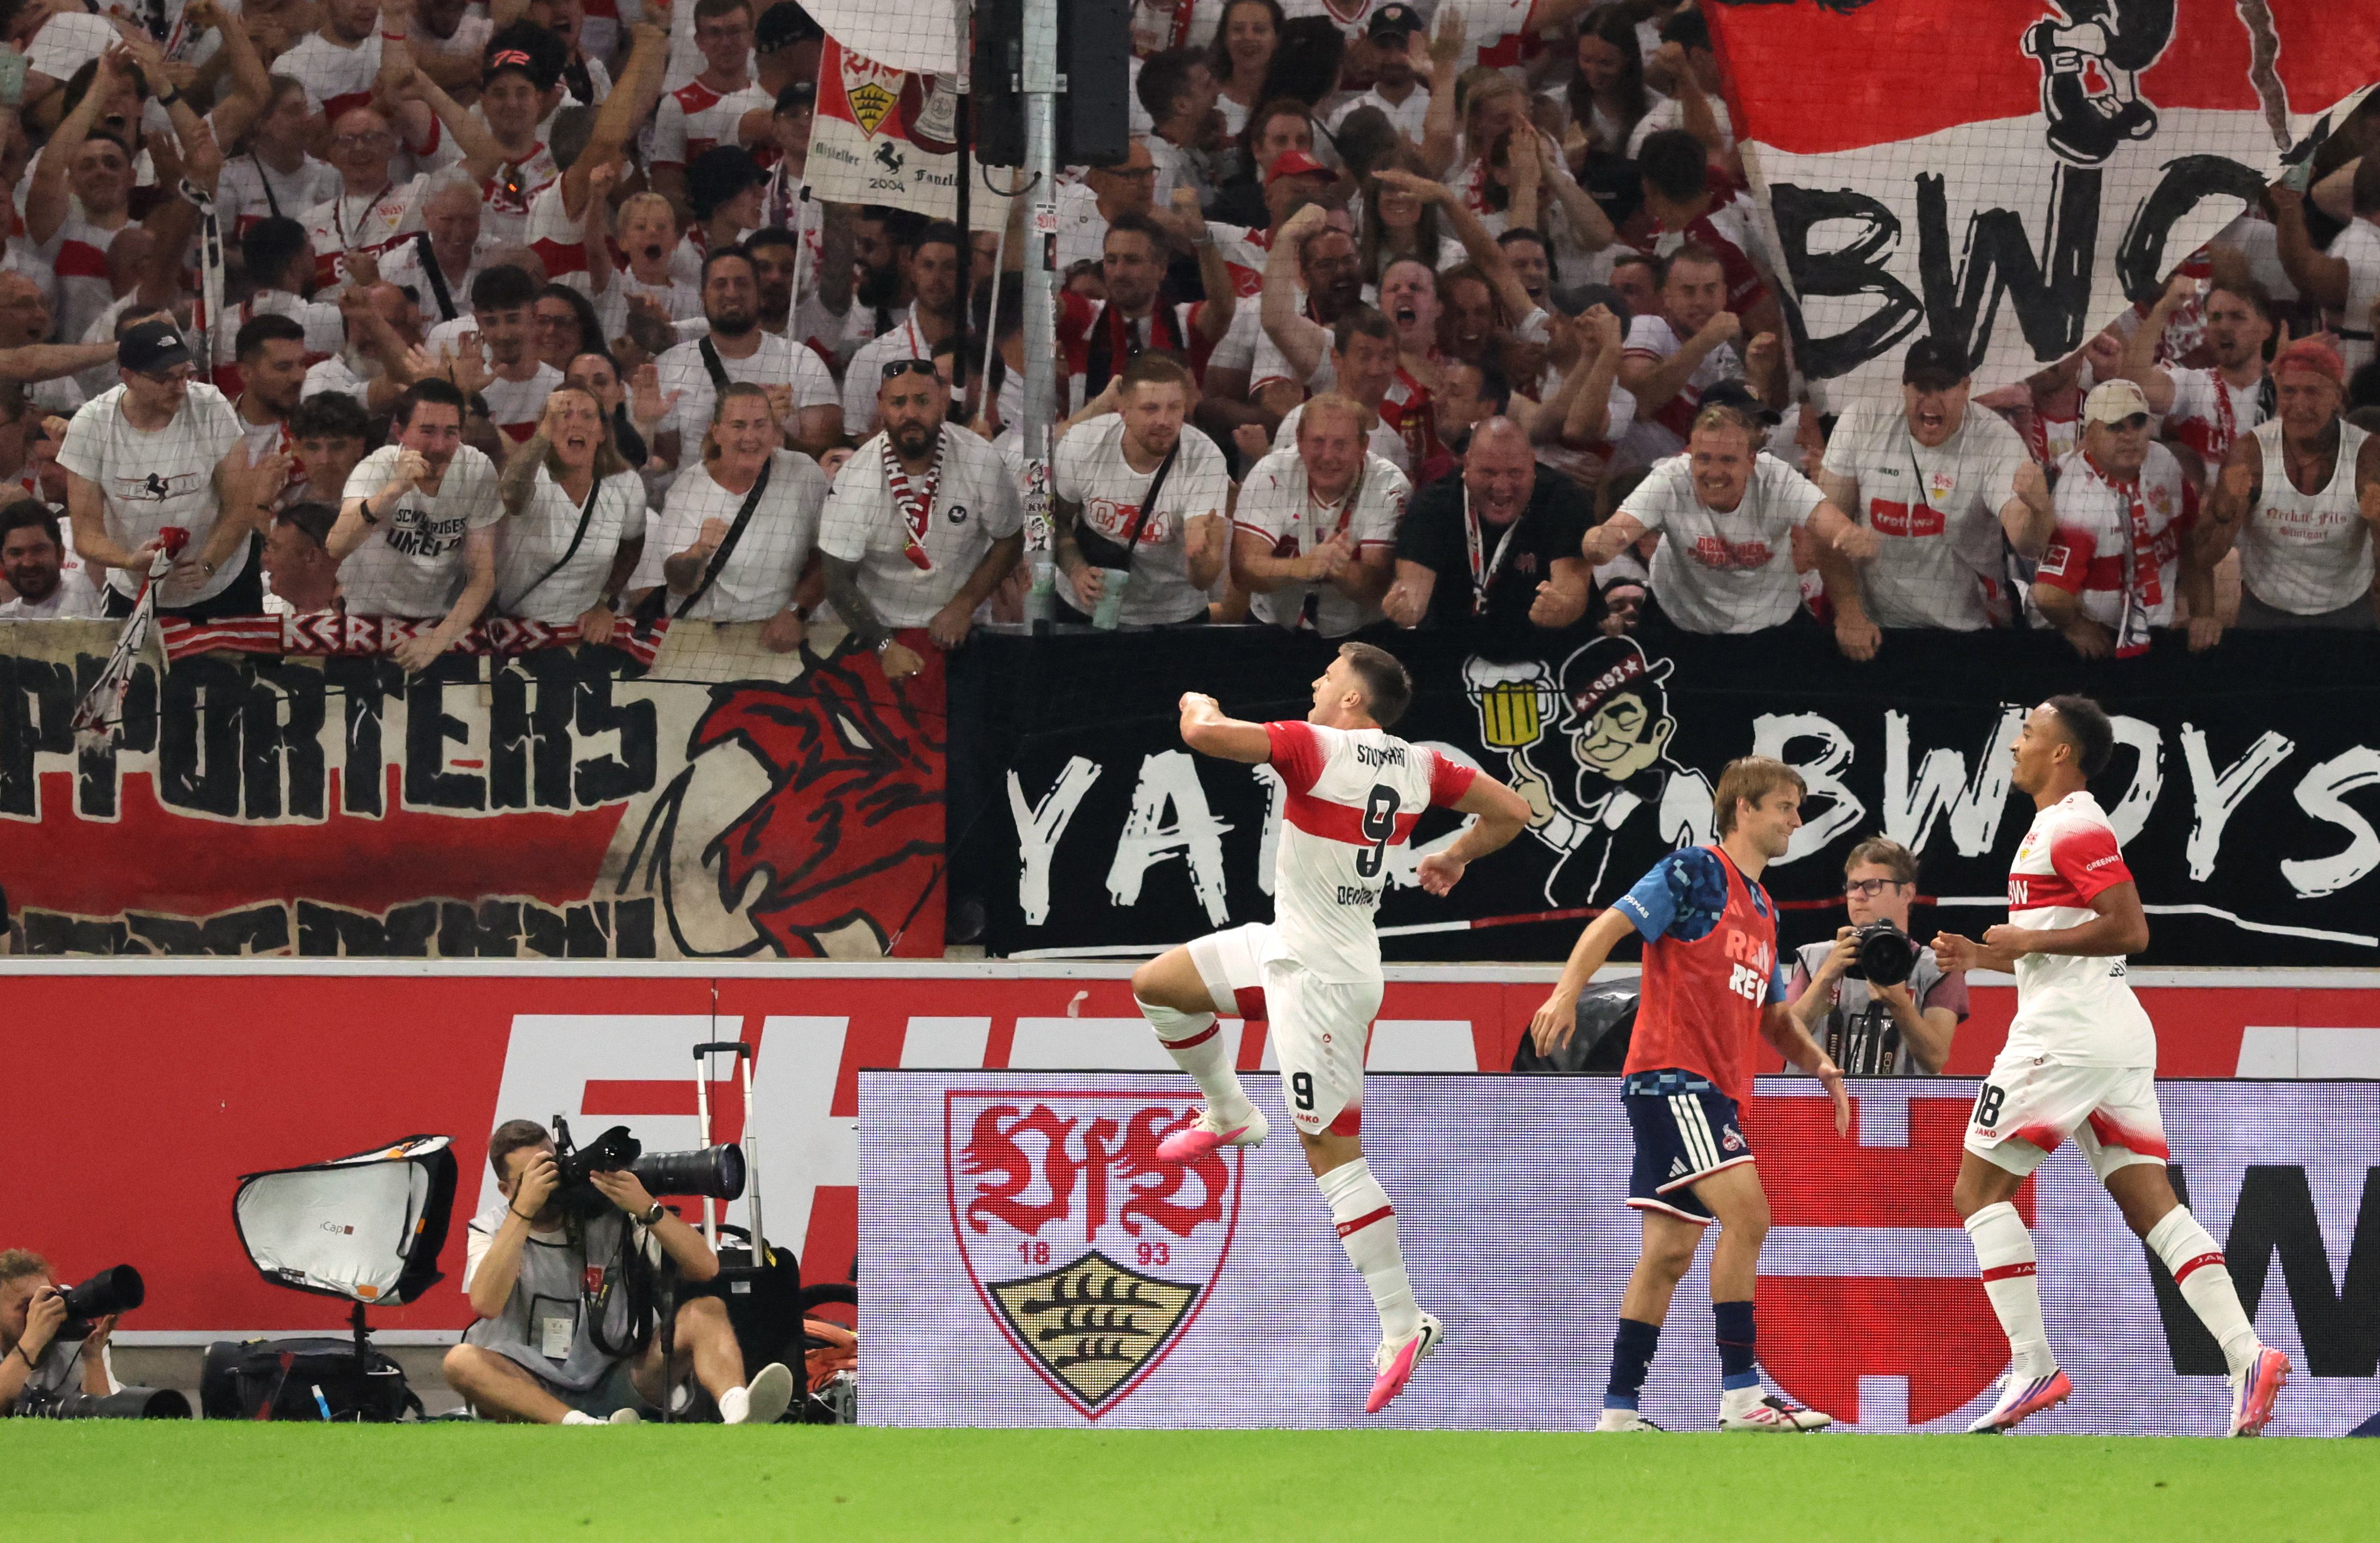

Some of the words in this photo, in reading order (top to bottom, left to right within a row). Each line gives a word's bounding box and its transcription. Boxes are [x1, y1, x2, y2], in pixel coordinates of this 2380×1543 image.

[493, 50, 530, 68] 72
[869, 178, 905, 193] 2004
[1356, 783, 1402, 878] 9
[1882, 1051, 1894, 1074] EOS
[1292, 1072, 1314, 1111] 9
[1973, 1082, 2005, 1128] 18
[1296, 1112, 1319, 1123] JAKO
[1975, 1127, 1997, 1139] JAKO
[1018, 1242, 1050, 1264] 18
[1135, 1242, 1170, 1266] 93
